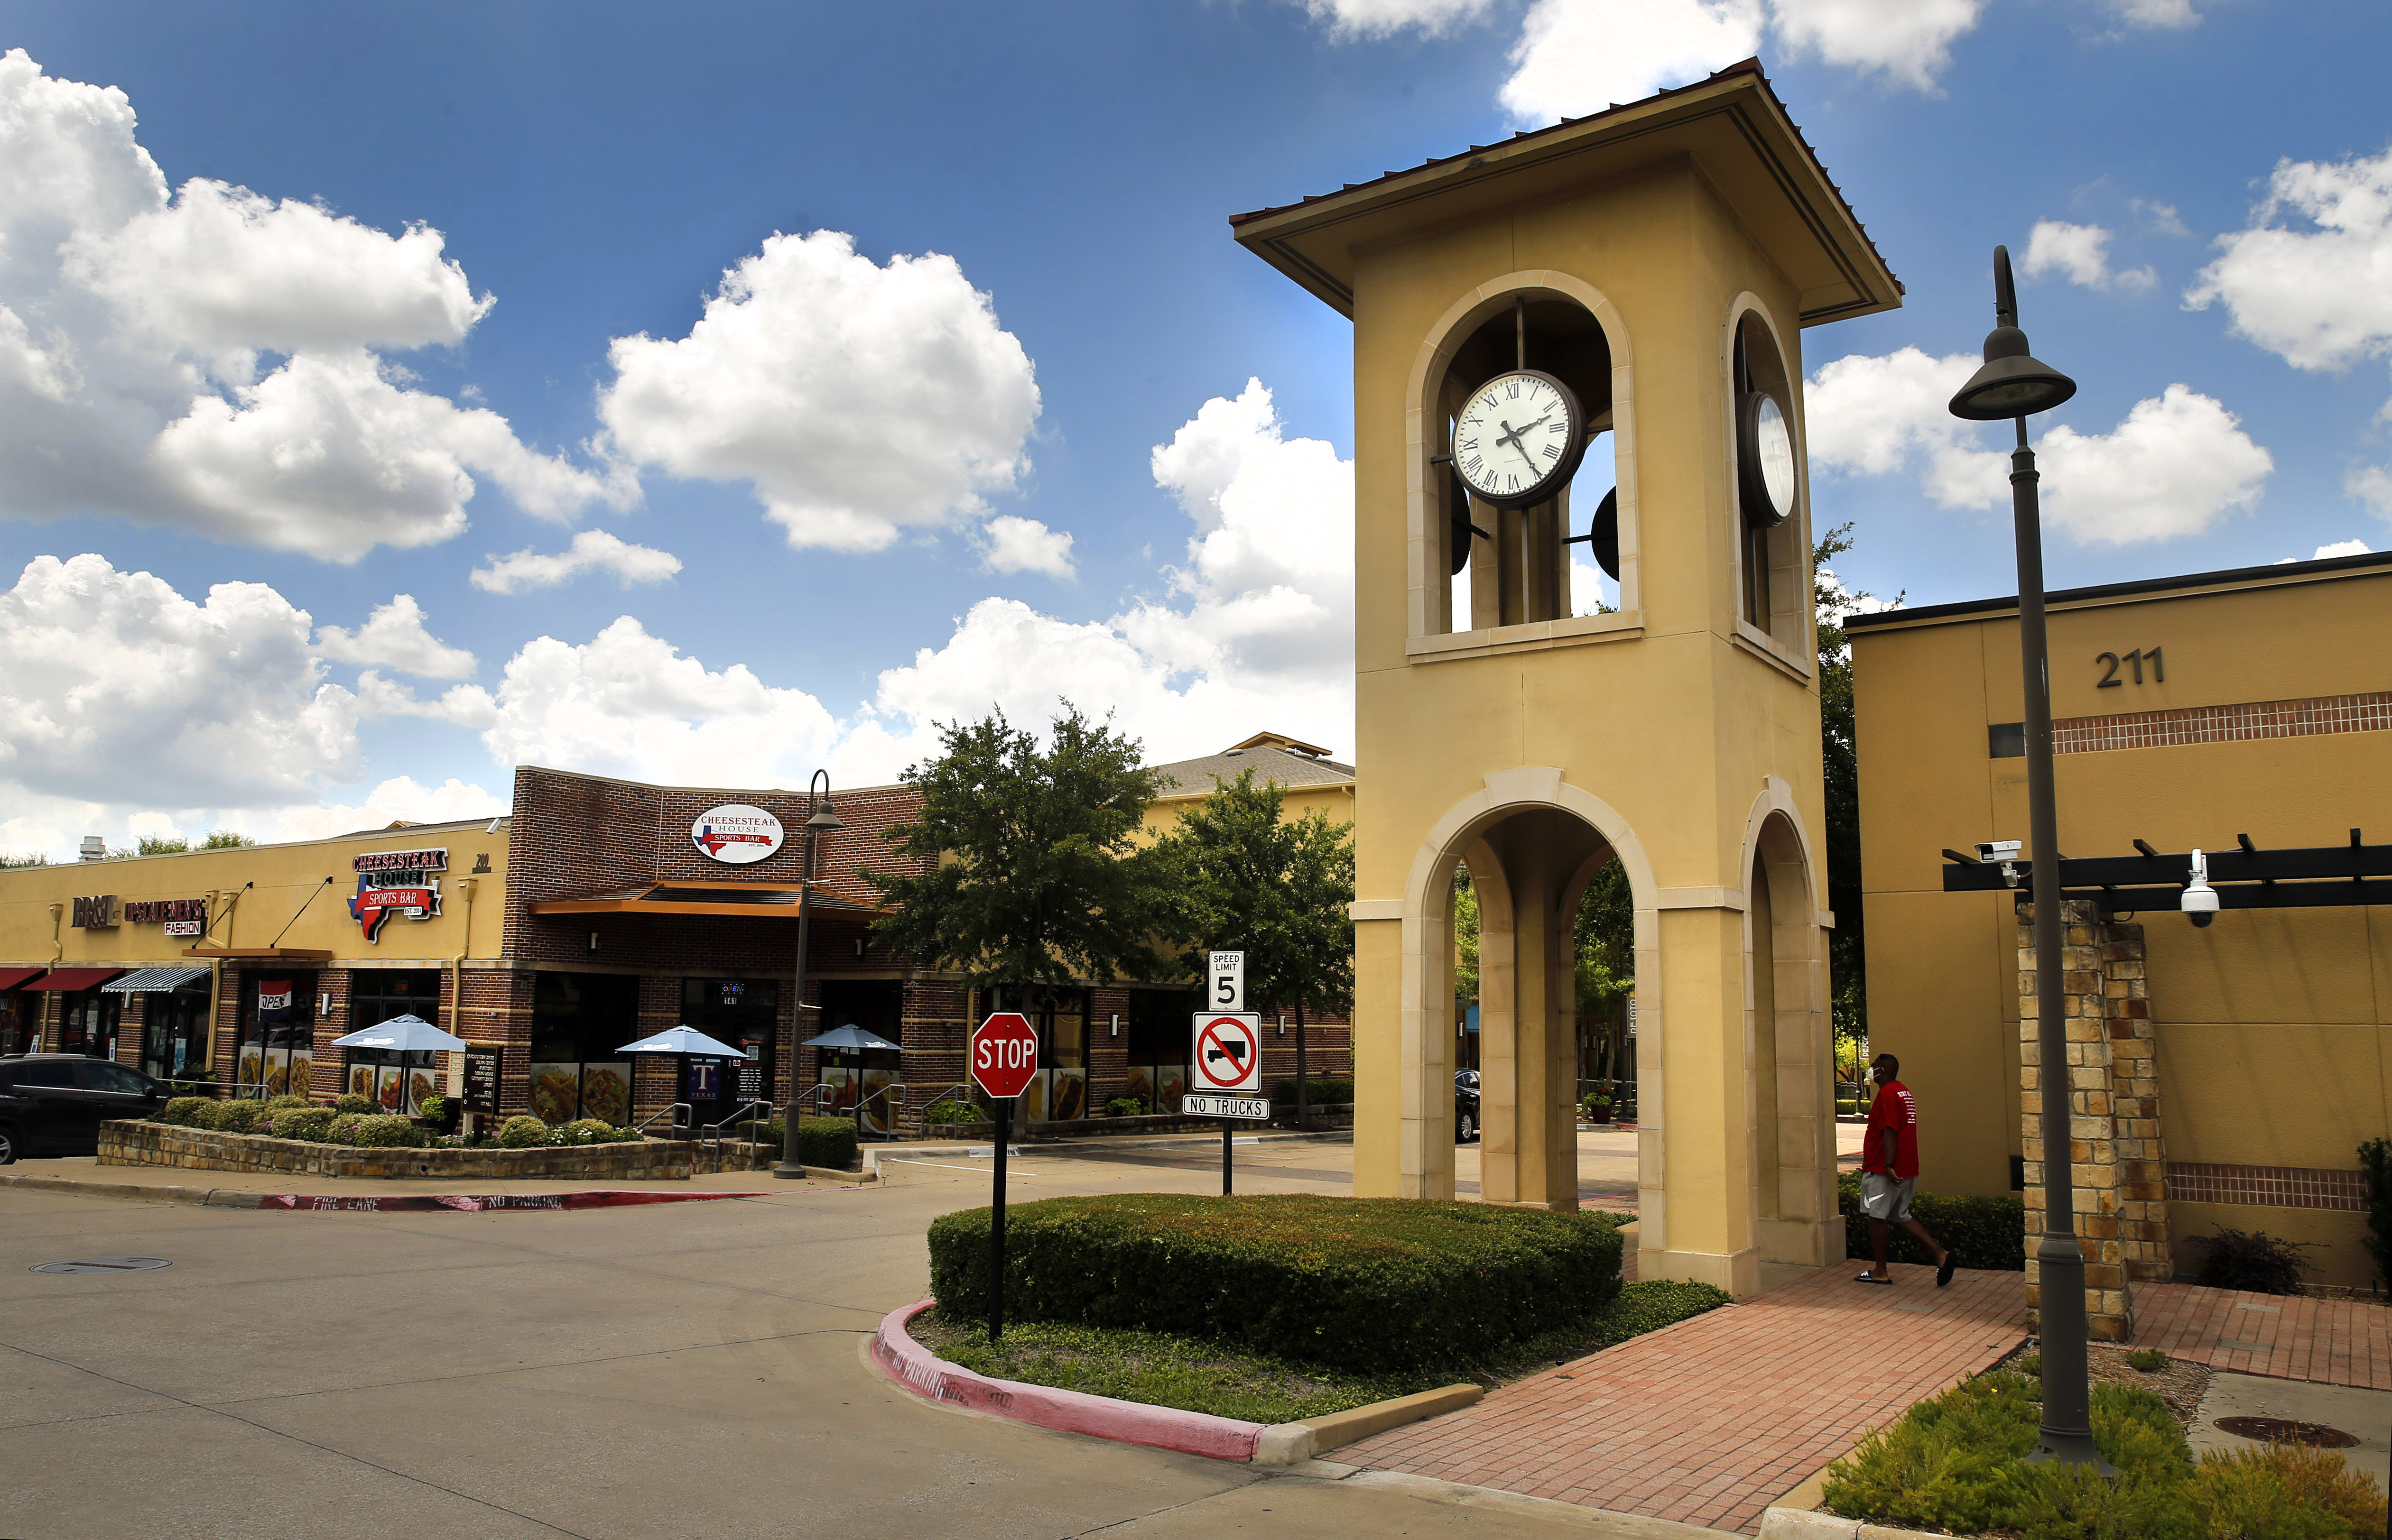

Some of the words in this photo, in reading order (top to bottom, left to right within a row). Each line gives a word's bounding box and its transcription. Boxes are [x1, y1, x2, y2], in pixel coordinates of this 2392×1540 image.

[2096, 646, 2163, 688] 211
[701, 816, 776, 826] CHEESESTEAK
[352, 851, 439, 872] CHEESESTEAK
[476, 853, 489, 867] 200
[373, 870, 418, 885] HOUSE
[369, 892, 397, 905] SPORTS
[399, 892, 417, 904] BAR
[71, 895, 116, 928] BB&T
[124, 901, 167, 922] UPSCALE
[168, 899, 202, 920] MEN'S
[166, 922, 199, 934] FASHION
[1214, 955, 1240, 963] SPEED
[1217, 976, 1235, 1004] 5
[977, 1039, 1035, 1069] STOP
[693, 1065, 715, 1089] T
[1190, 1098, 1206, 1112] NO
[1215, 1099, 1261, 1116] TRUCKS
[312, 1197, 342, 1211] FIRE
[347, 1197, 381, 1212] LANE
[489, 1196, 505, 1208] NO
[513, 1195, 563, 1209] PARKING
[902, 1358, 947, 1401] PARKING
